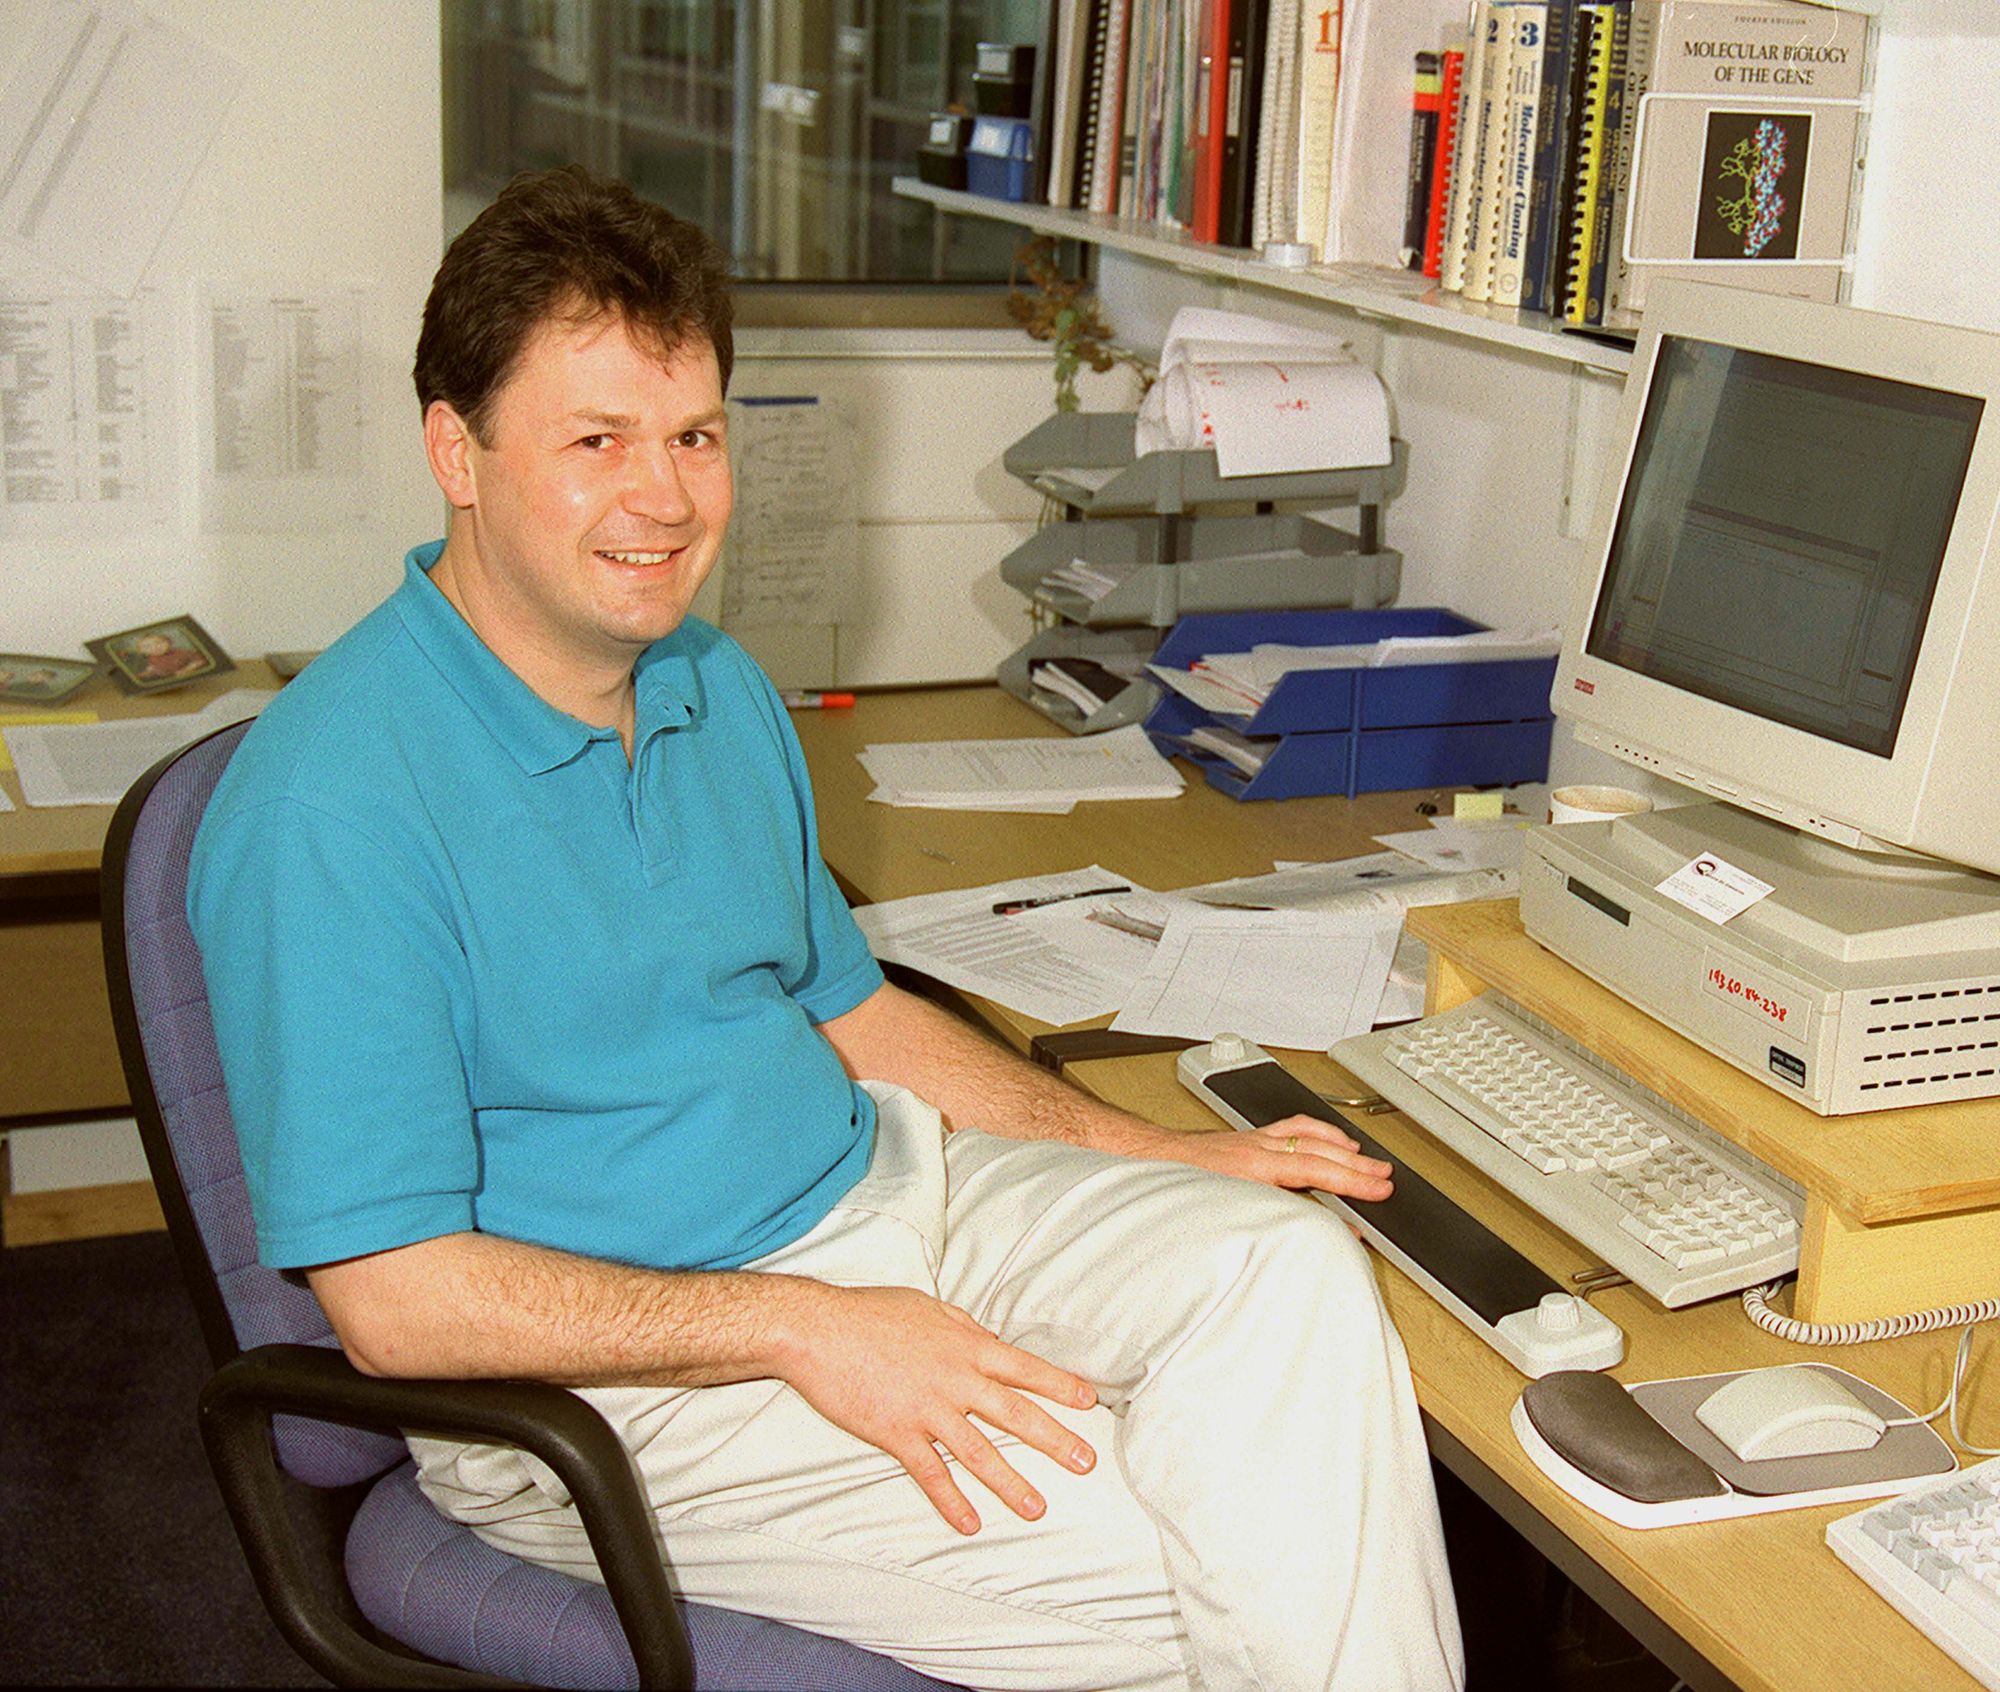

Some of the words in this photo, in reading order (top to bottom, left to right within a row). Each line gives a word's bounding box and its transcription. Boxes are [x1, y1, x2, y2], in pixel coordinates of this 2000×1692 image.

[1520, 21, 1539, 47] 3
[1684, 41, 1779, 61] MOLECULAR
[1783, 45, 1849, 64] BIOLOGY
[1714, 65, 1736, 83] OF
[1739, 66, 1770, 84] THE
[1773, 67, 1815, 85] GENE
[1608, 90, 1620, 109] 4
[1515, 105, 1534, 189] Molecular
[1507, 191, 1526, 259] Cloning
